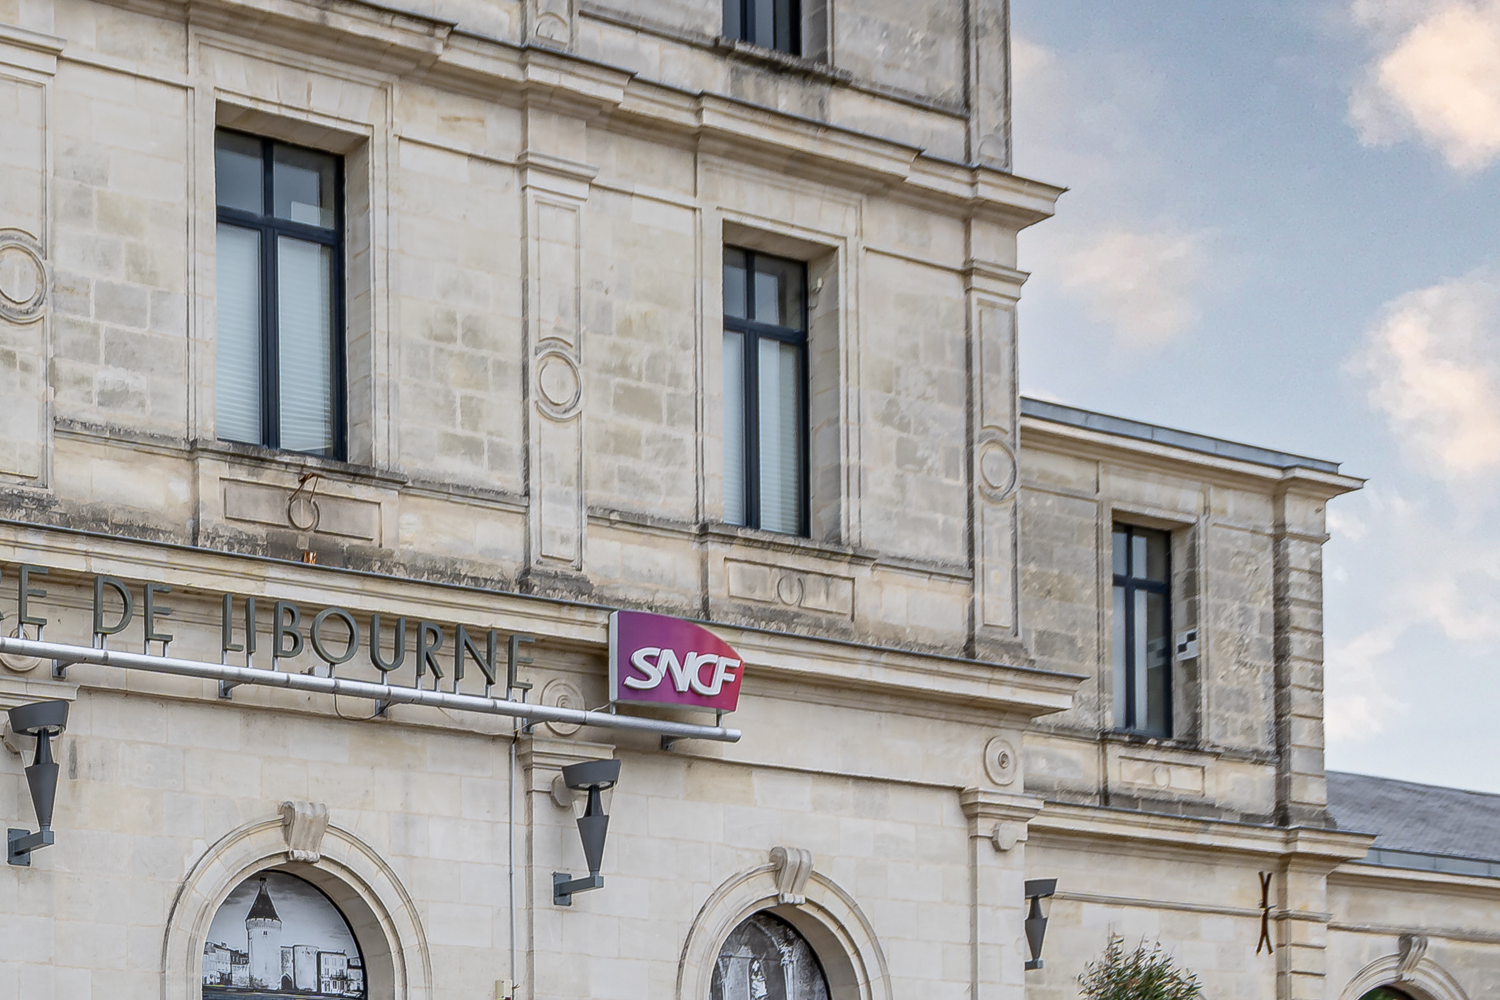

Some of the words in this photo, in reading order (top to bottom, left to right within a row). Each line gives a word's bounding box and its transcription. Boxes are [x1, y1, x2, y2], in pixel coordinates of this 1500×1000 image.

[93, 575, 174, 643] DE
[221, 593, 536, 690] LIBOURNE
[623, 646, 742, 697] SNCF
